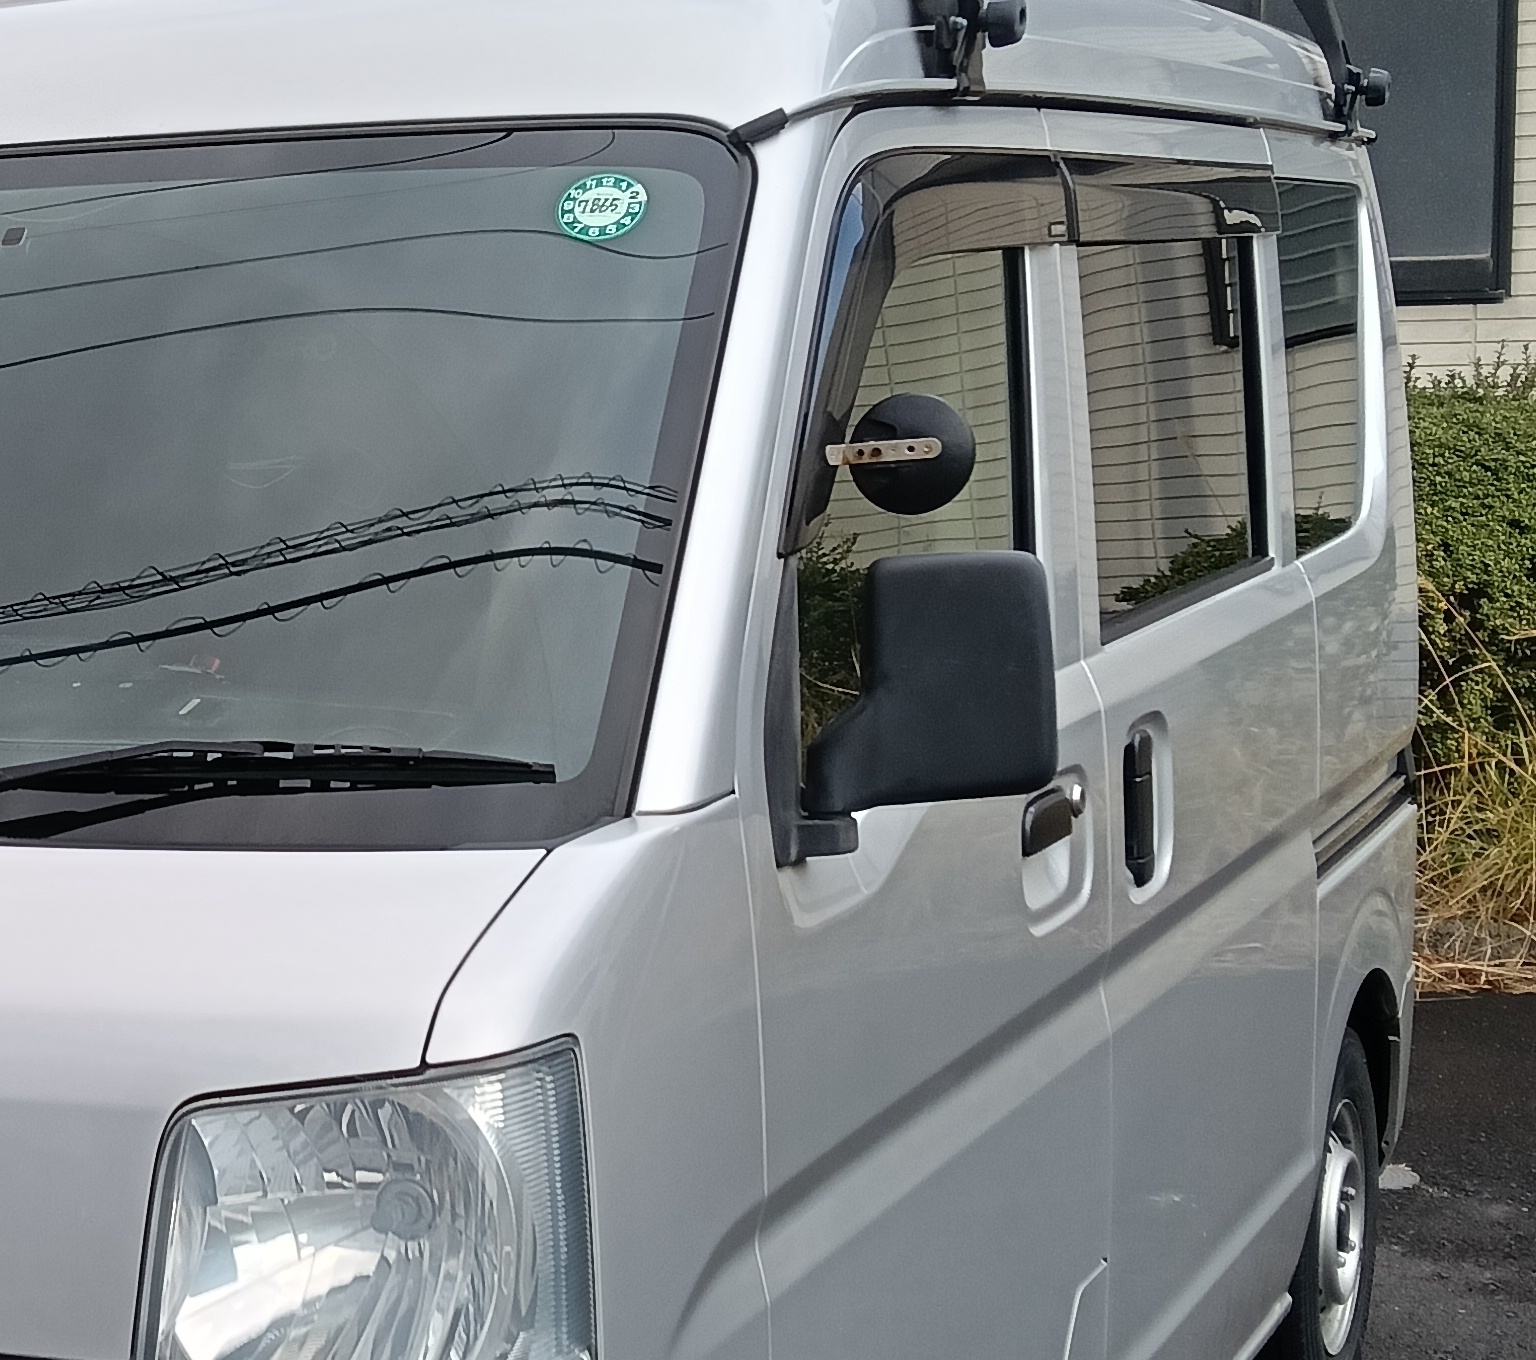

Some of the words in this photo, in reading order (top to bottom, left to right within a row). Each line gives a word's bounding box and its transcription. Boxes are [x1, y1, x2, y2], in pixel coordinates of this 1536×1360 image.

[585, 179, 597, 189] 11
[601, 177, 615, 186] 12
[619, 181, 628, 190] 1
[569, 188, 583, 198] 10
[628, 190, 640, 200] 2
[619, 215, 632, 226] 4
[572, 223, 585, 233] 7
